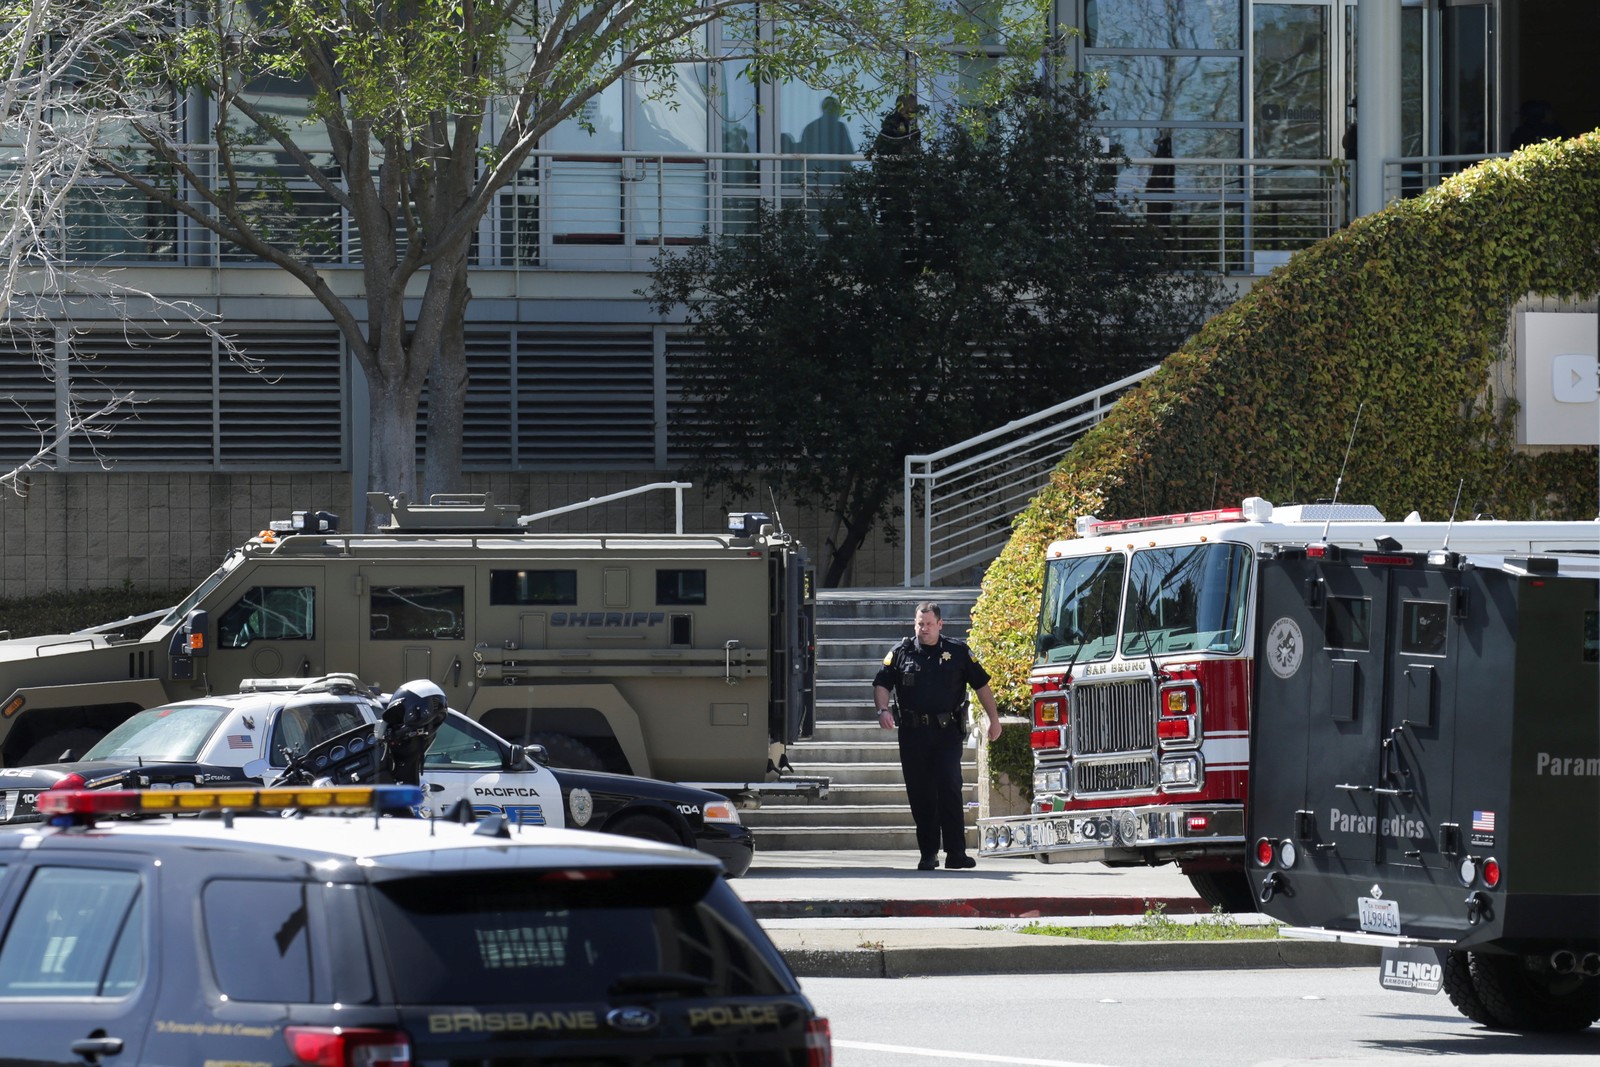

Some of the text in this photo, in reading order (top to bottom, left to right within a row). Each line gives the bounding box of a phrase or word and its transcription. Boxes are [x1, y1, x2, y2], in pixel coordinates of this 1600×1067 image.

[550, 612, 665, 627] SHERIFF
[1086, 661, 1147, 676] SAN BRUNO
[1537, 752, 1600, 776] Param
[203, 773, 231, 781] Service
[474, 787, 540, 797] PACIFICA
[676, 804, 700, 815] 104
[1362, 911, 1398, 928] 1499454
[1384, 960, 1442, 981] LENCO
[1417, 981, 1439, 989] VEHICLES
[428, 1006, 779, 1033] BRISBANE POLICE
